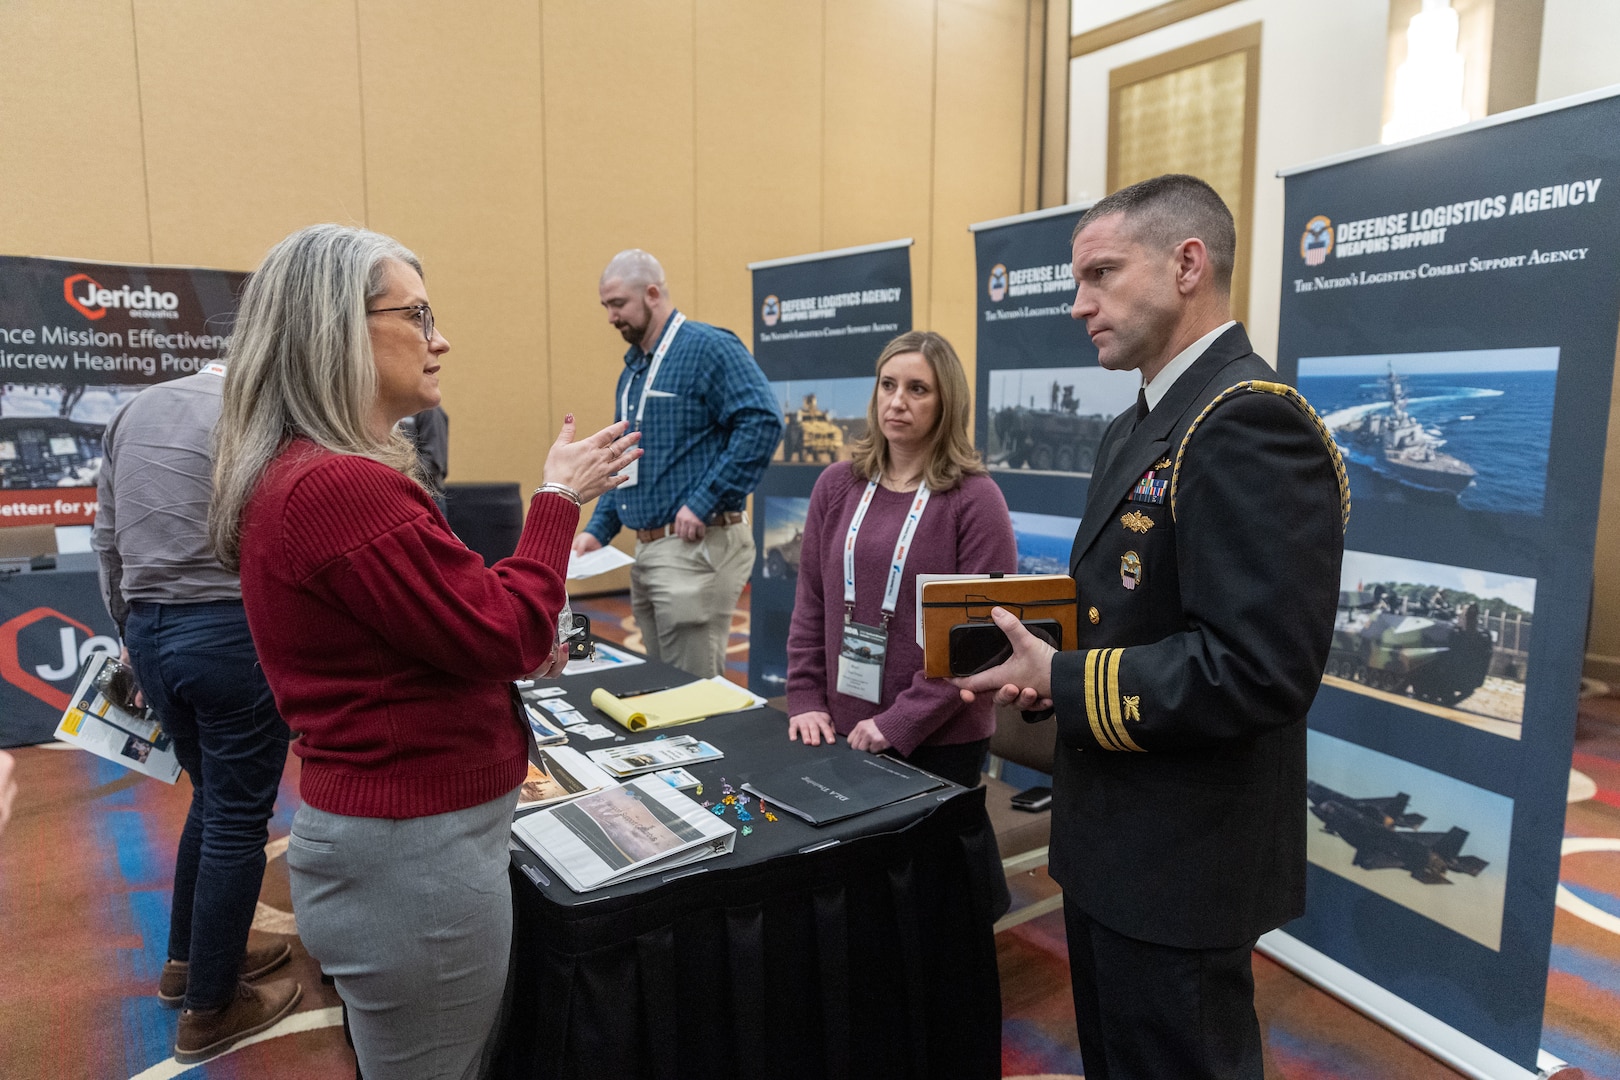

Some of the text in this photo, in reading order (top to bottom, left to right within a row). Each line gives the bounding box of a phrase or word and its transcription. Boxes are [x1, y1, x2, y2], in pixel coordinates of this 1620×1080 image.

[1336, 178, 1602, 243] DEFENSE LOGISTICS AGENCY
[1335, 227, 1448, 259] WEAPONS SUPPORT
[1008, 265, 1053, 286] DEFENSE
[78, 283, 179, 310] Jericho
[781, 287, 902, 312] DEFENSE LOGISTICS AGENCY
[1009, 283, 1043, 297] WEAPONS
[42, 325, 123, 347] Mission
[0, 349, 68, 370] ircrew
[73, 351, 156, 377] Hearing
[0, 502, 52, 517] etter:
[54, 499, 81, 515] for
